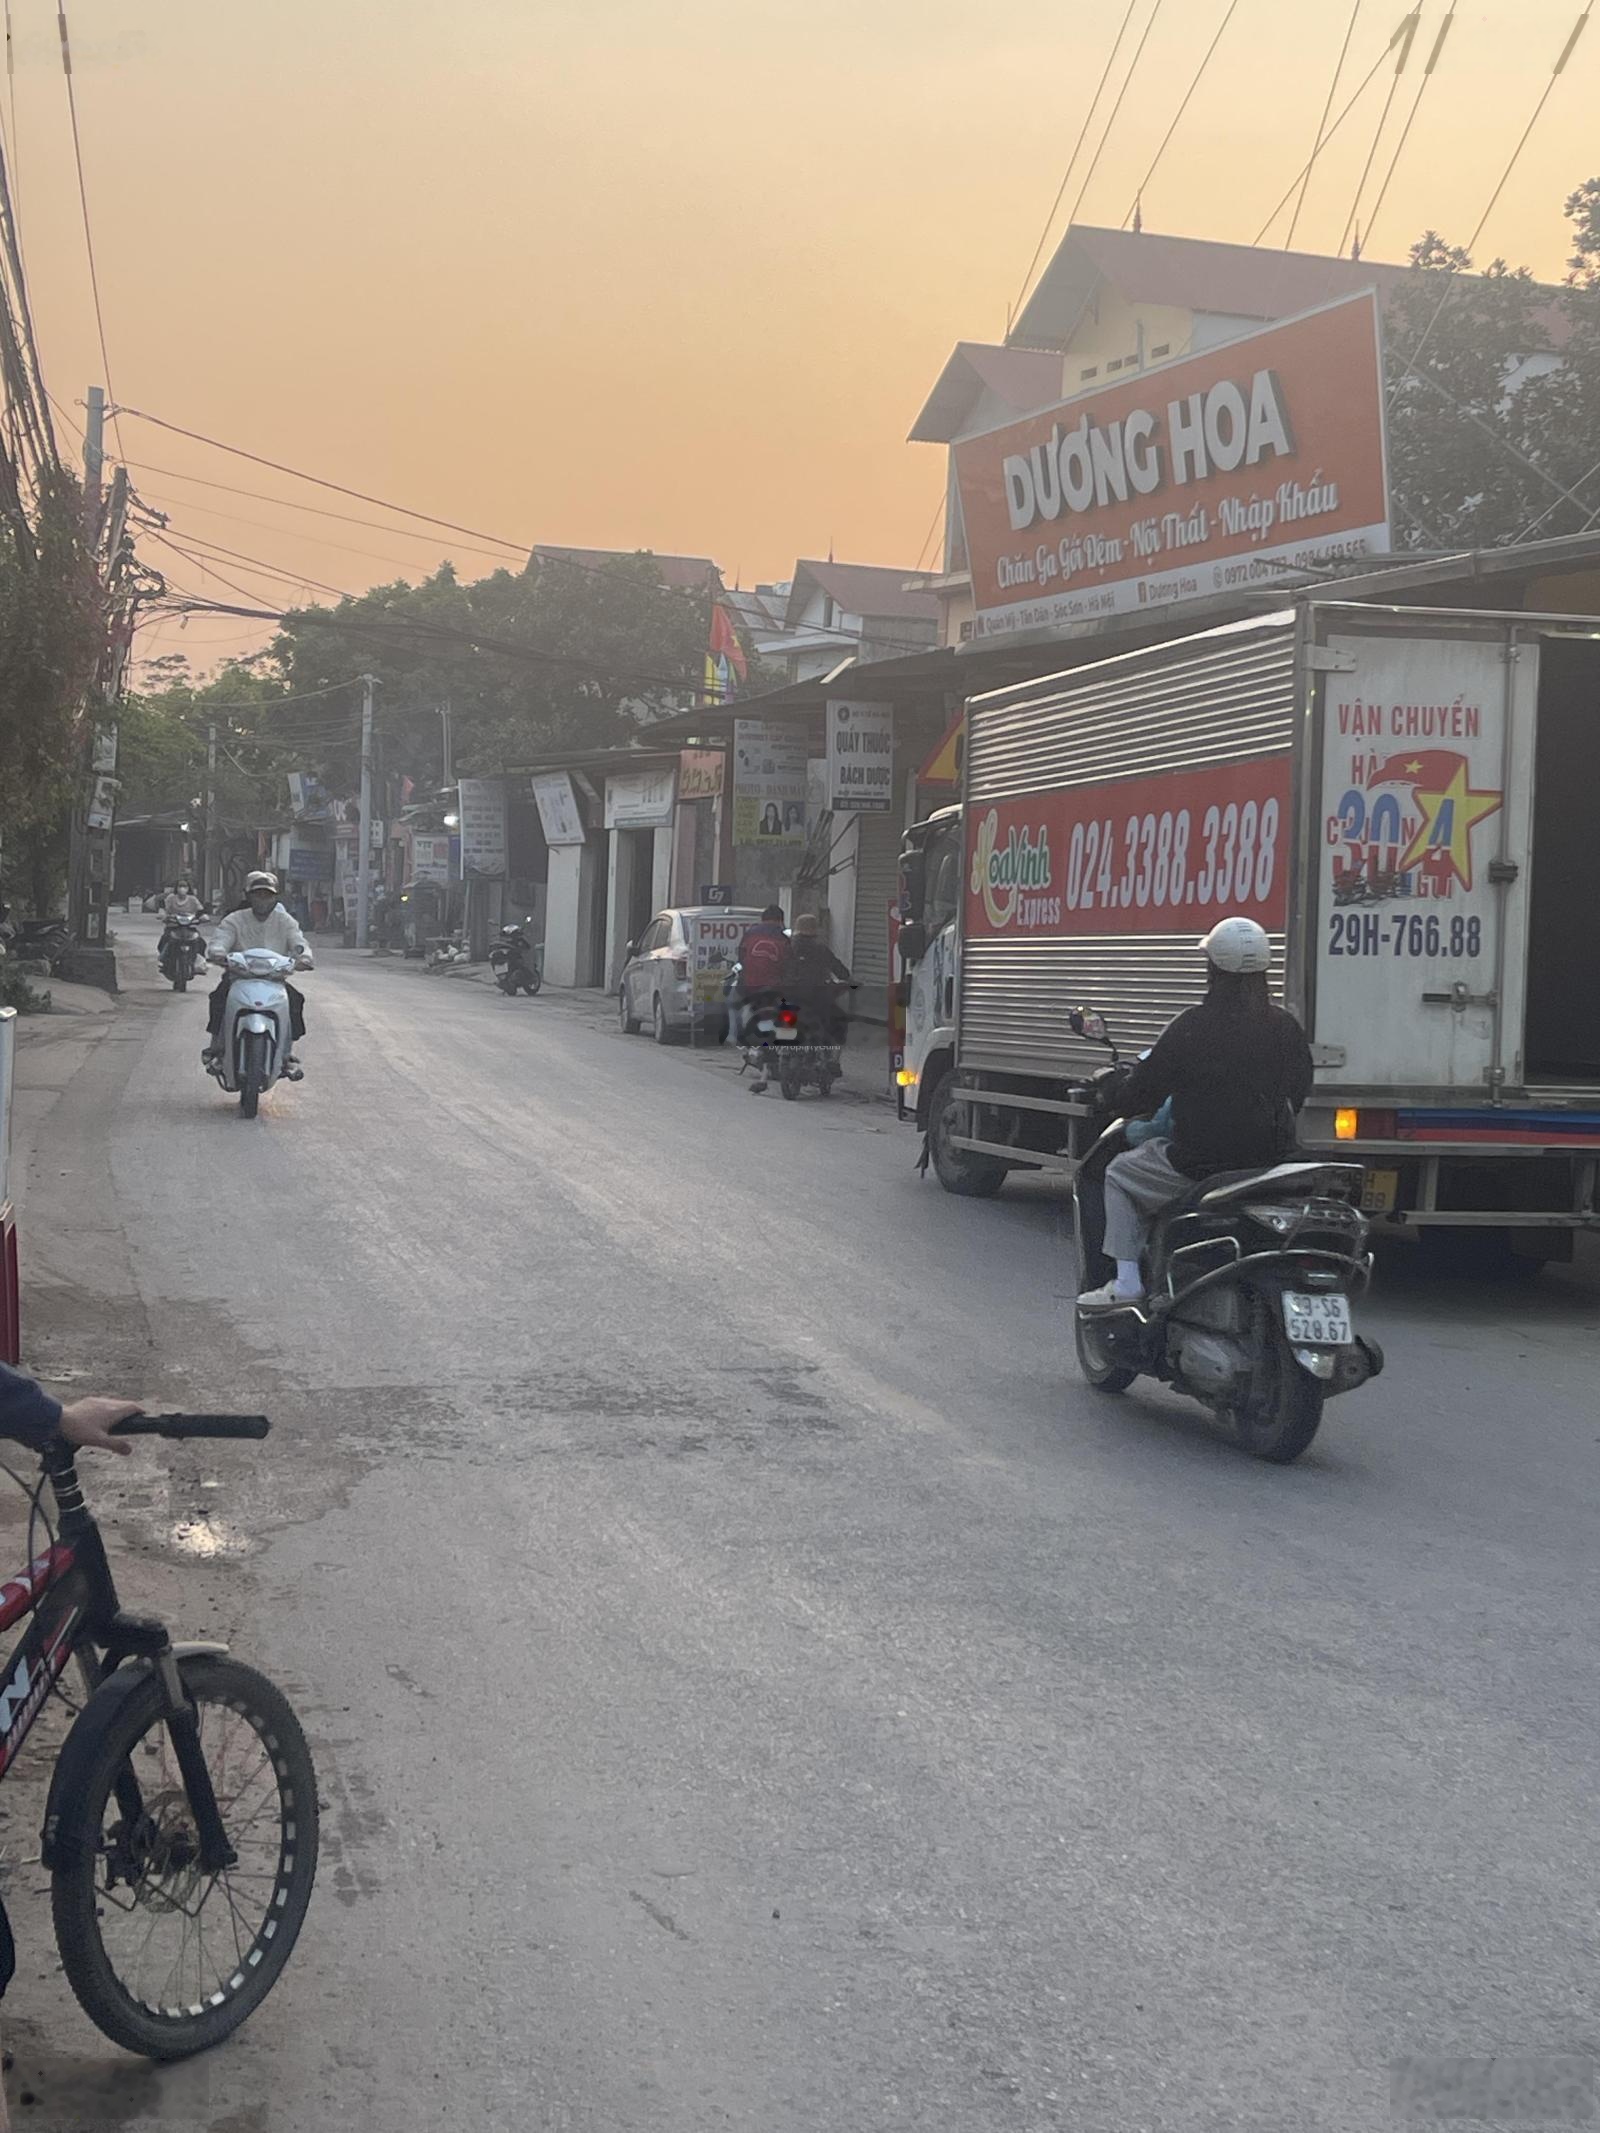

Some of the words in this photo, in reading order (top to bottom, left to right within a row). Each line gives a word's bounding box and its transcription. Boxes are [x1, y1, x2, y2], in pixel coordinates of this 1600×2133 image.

[1003, 409, 1160, 530] DƯƠNG
[1167, 369, 1293, 485] HOA
[996, 554, 1036, 589] Chăn
[1036, 544, 1057, 586] Ga
[1058, 533, 1084, 582] Gối
[1083, 527, 1123, 577] Đệm
[1130, 517, 1160, 567] Nội
[1161, 501, 1209, 554] Thất
[1217, 490, 1274, 542] Nhập
[1276, 467, 1338, 523] Khẩu
[1338, 698, 1382, 742] VẬN
[1391, 694, 1480, 738] CHUYỂN
[1066, 797, 1279, 912] 024.3388.3388
[1017, 894, 1060, 929] Express
[1328, 914, 1481, 958] 29H-766.88
